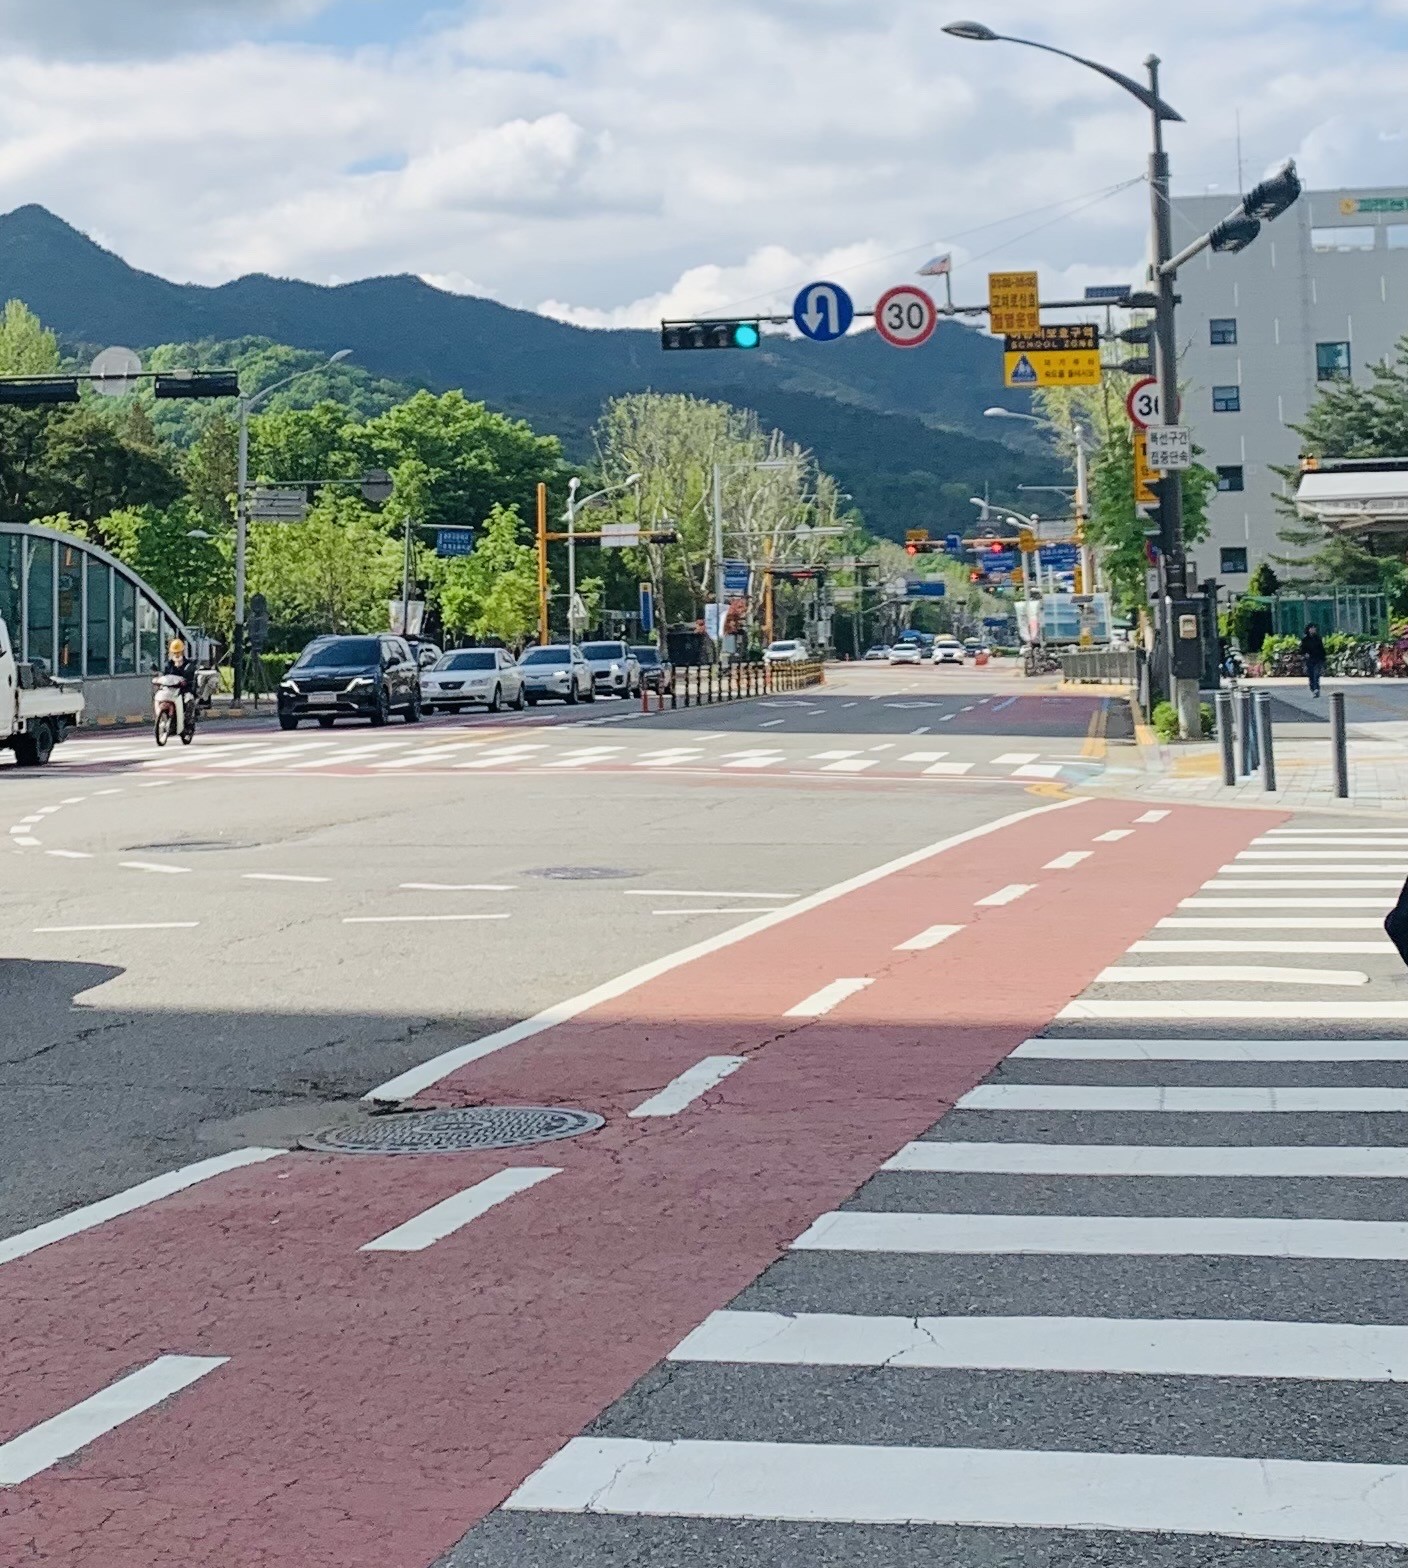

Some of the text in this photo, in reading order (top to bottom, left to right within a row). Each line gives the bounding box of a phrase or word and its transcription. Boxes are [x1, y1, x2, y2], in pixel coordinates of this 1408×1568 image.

[887, 302, 924, 330] 30
[1010, 340, 1058, 350] SCHOOL
[1150, 450, 1188, 466] 집중단속
